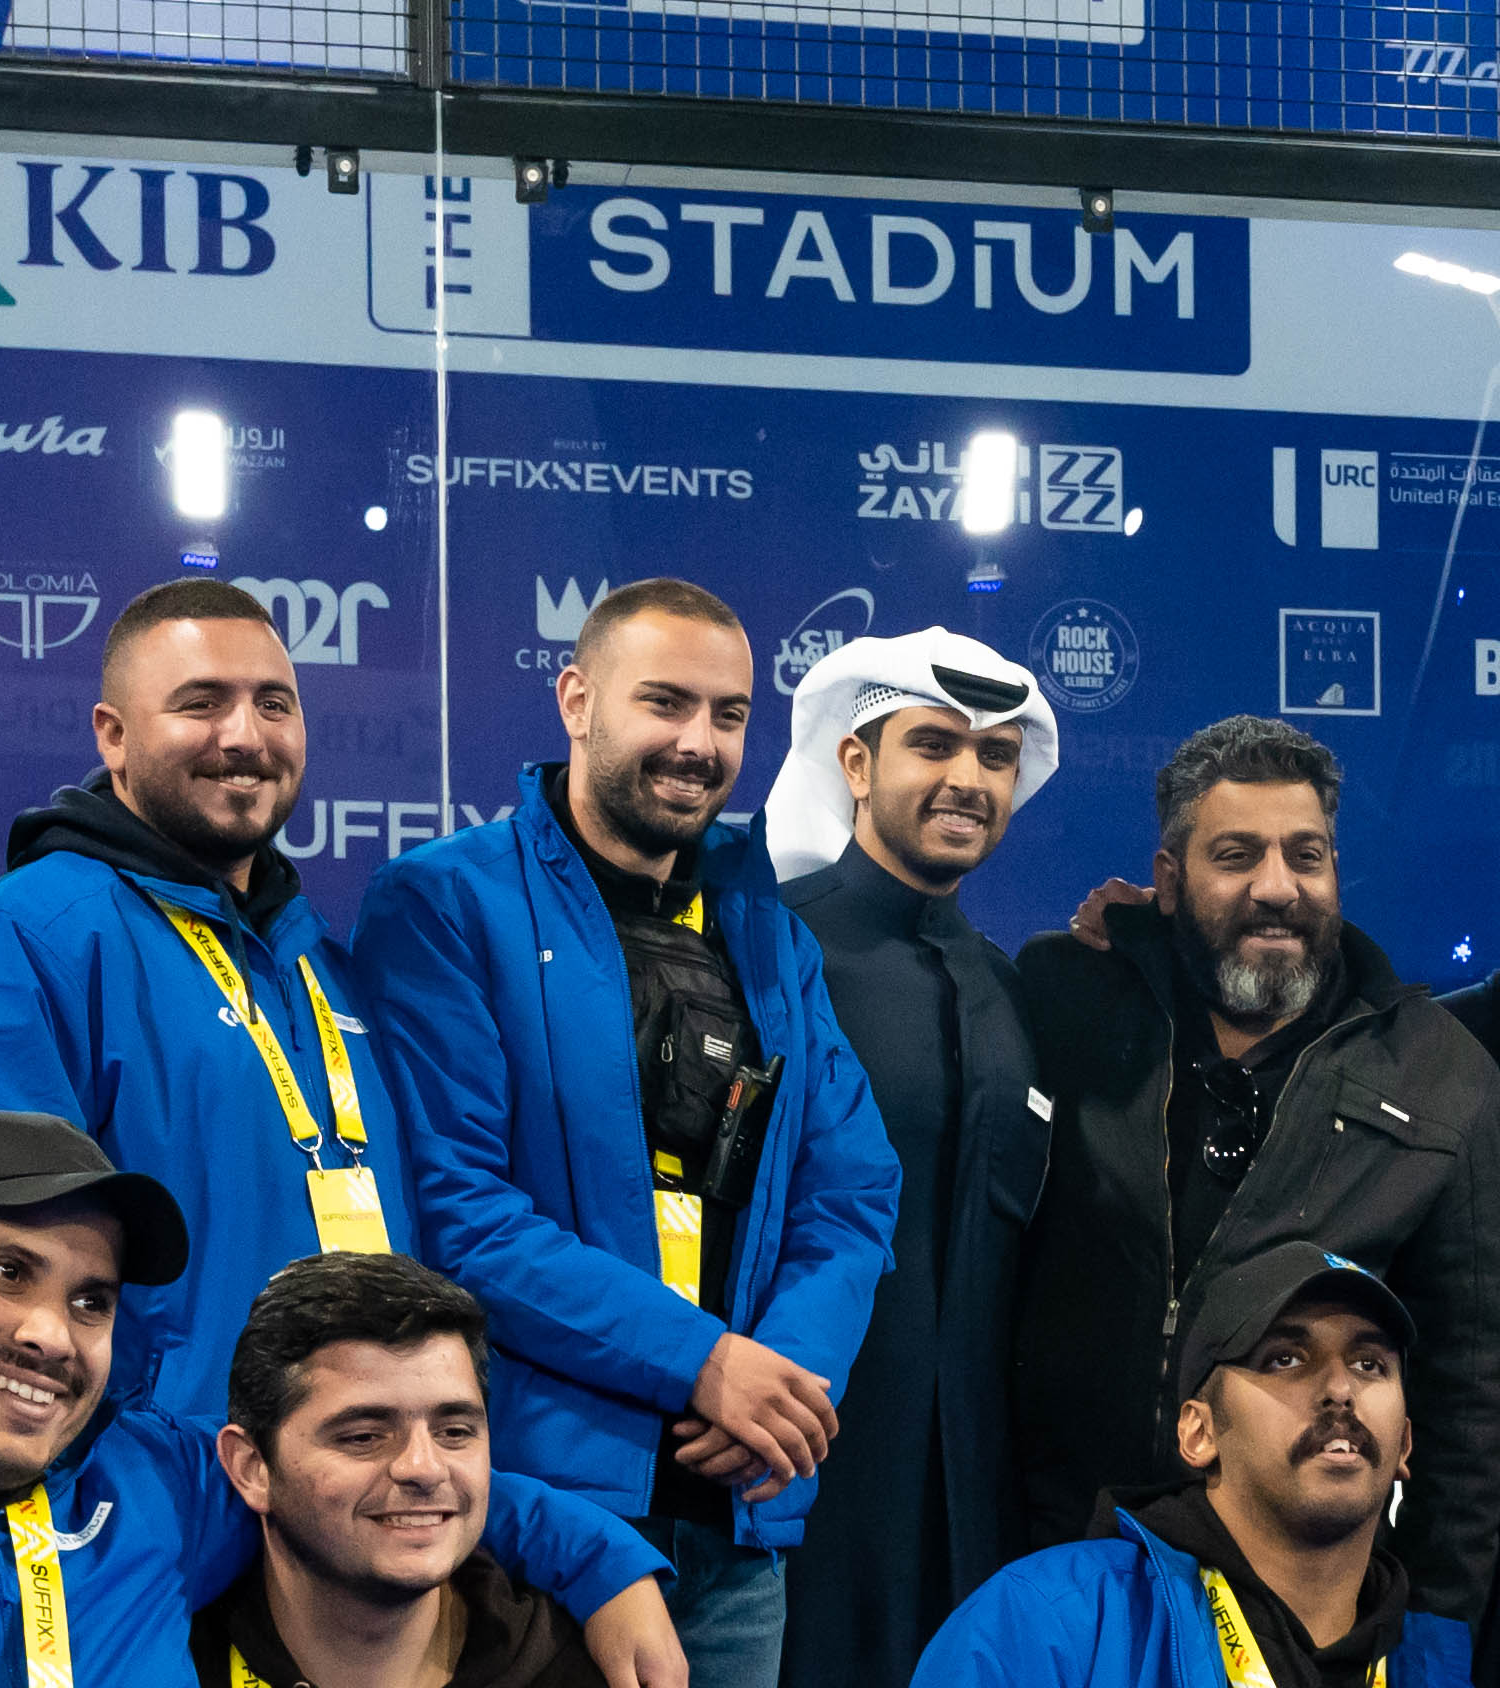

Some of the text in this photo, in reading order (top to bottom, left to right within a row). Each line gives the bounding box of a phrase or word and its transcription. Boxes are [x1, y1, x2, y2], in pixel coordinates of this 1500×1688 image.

[17, 161, 276, 277] KIB
[589, 197, 1195, 321] STADIUM
[1325, 463, 1376, 488] URC
[1389, 462, 1446, 482] المتحدة
[857, 483, 1031, 524] ZAYI
[1390, 486, 1444, 505] United
[1449, 488, 1483, 506] Real
[1058, 626, 1110, 650] ROCK
[1293, 619, 1368, 635] ACQUA
[1052, 651, 1116, 676] HOUSE
[1303, 649, 1358, 664] ELBA
[1064, 676, 1105, 689] SLIDERS
[264, 1041, 299, 1110] SUFFIX
[31, 1563, 55, 1639] SUFFIX
